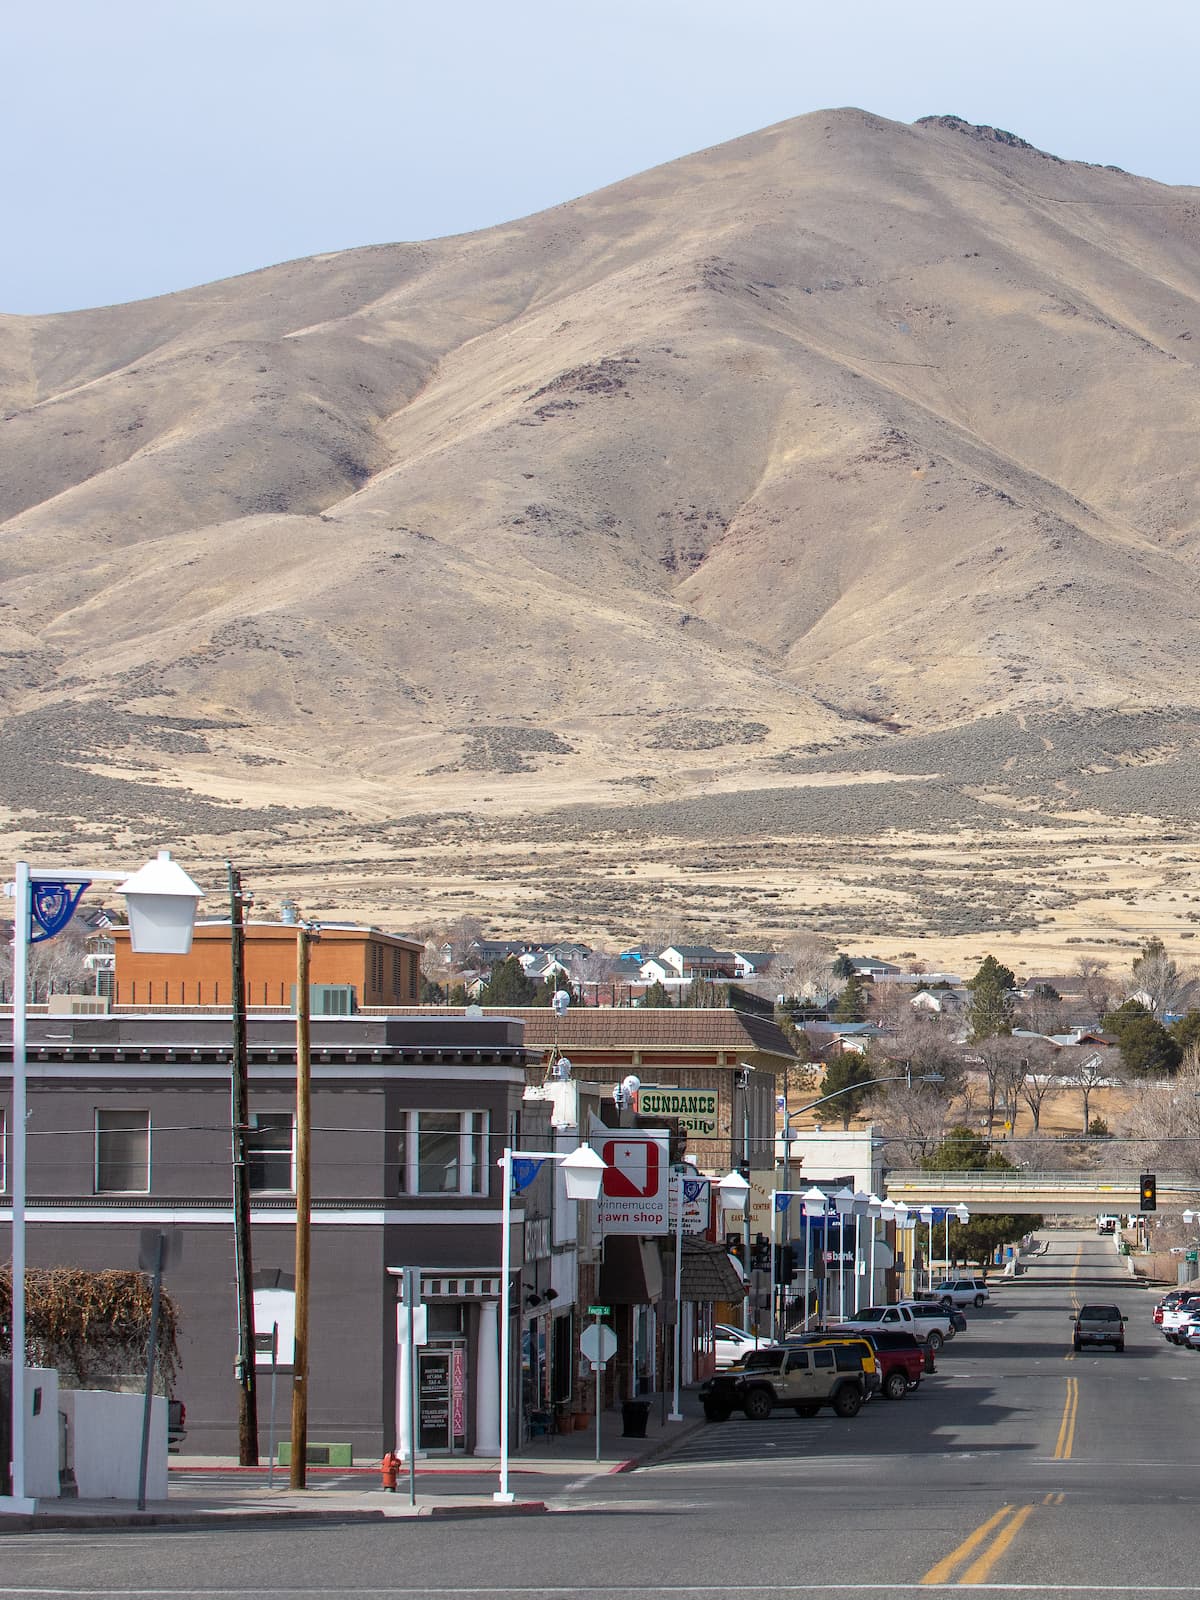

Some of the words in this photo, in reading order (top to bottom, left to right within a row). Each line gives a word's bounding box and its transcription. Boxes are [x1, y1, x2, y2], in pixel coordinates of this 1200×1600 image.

[643, 1095, 715, 1113] SUNDANCE
[679, 1117, 714, 1134] asino
[597, 1200, 663, 1210] winnemucca
[597, 1213, 630, 1225] pawn
[633, 1212, 663, 1225] shop
[833, 1250, 854, 1261] bank
[454, 1355, 463, 1386] TAX
[454, 1398, 463, 1429] TAX
